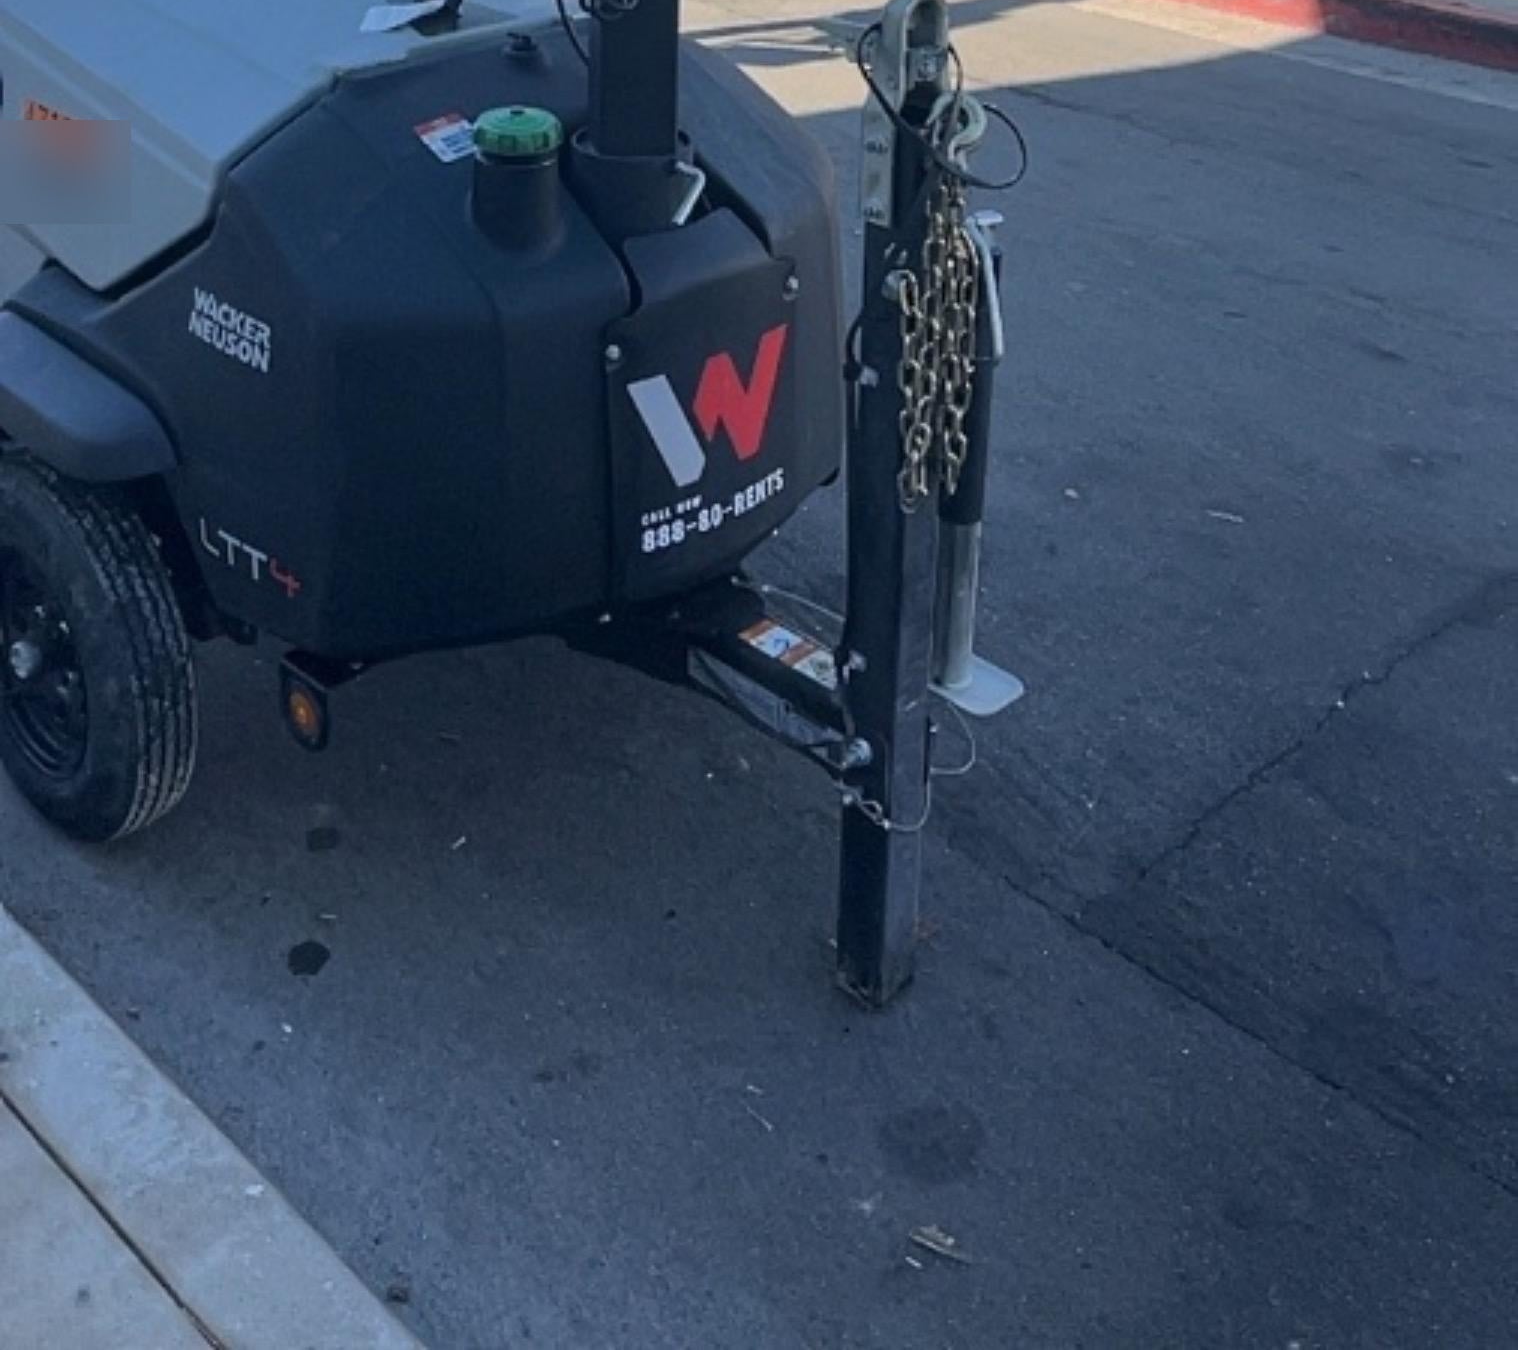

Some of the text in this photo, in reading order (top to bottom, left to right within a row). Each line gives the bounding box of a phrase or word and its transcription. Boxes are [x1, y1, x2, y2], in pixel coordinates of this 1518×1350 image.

[188, 310, 270, 373] NEUSON
[193, 286, 271, 349] WACKER
[641, 467, 785, 553] 888-80-RENTS
[200, 517, 301, 598] LTT4
